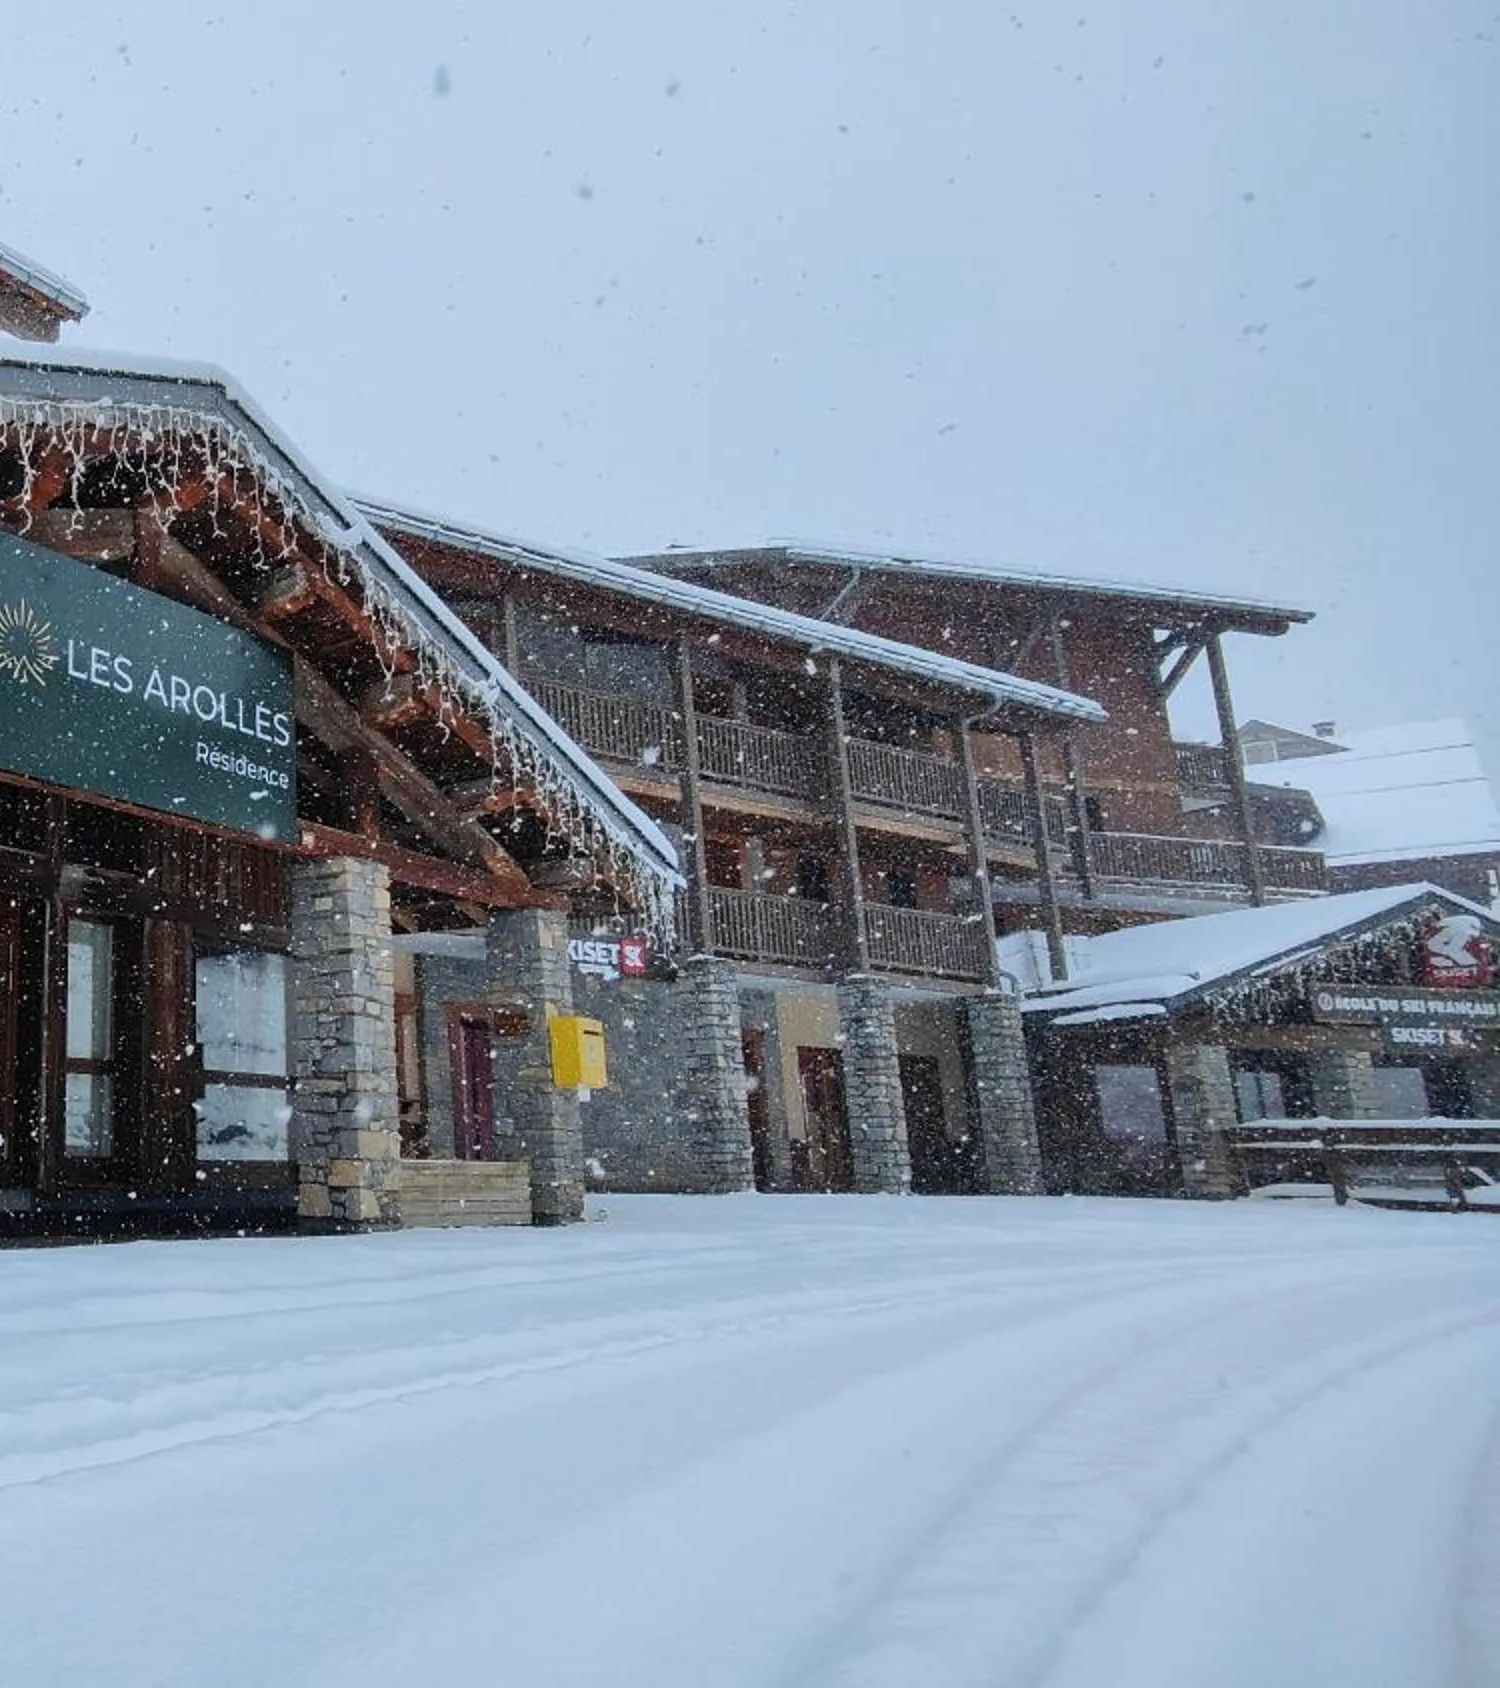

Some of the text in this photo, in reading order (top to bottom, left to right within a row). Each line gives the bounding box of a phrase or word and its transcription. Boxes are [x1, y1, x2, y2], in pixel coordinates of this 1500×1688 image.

[67, 639, 133, 693] LES
[195, 741, 290, 789] Résidence
[567, 939, 620, 965] KISET
[1391, 1026, 1445, 1046] SKISET
